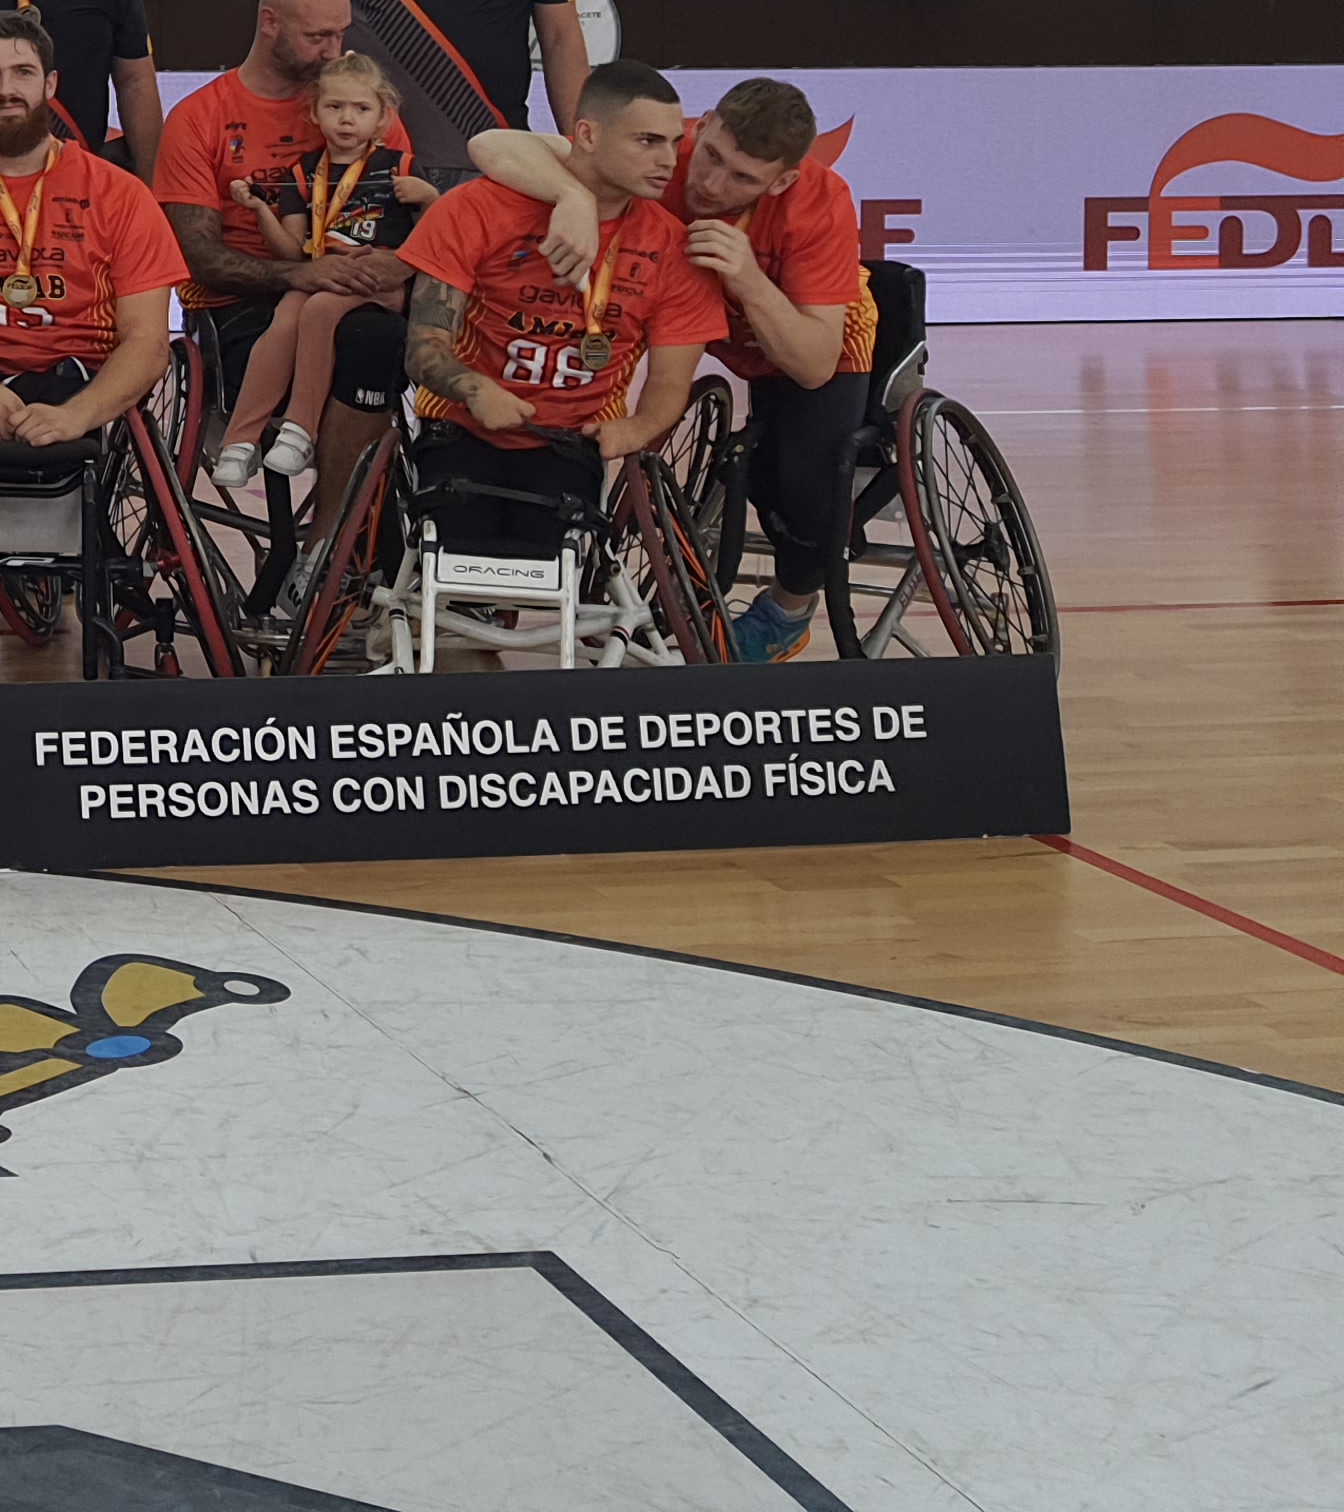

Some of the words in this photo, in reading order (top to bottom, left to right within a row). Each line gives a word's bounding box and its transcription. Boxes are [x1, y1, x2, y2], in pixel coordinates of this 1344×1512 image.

[351, 221, 376, 240] 19
[34, 718, 316, 766] FEDERACIÓN
[331, 711, 558, 760] ESPAÑOLA
[572, 715, 627, 751] DE
[639, 708, 862, 748] DEPORTES
[873, 704, 927, 740] DE
[79, 779, 319, 820] PERSONAS
[332, 774, 425, 813] CON
[439, 763, 751, 810] DISCAPACIDAD
[764, 751, 895, 800] FÍSICA
